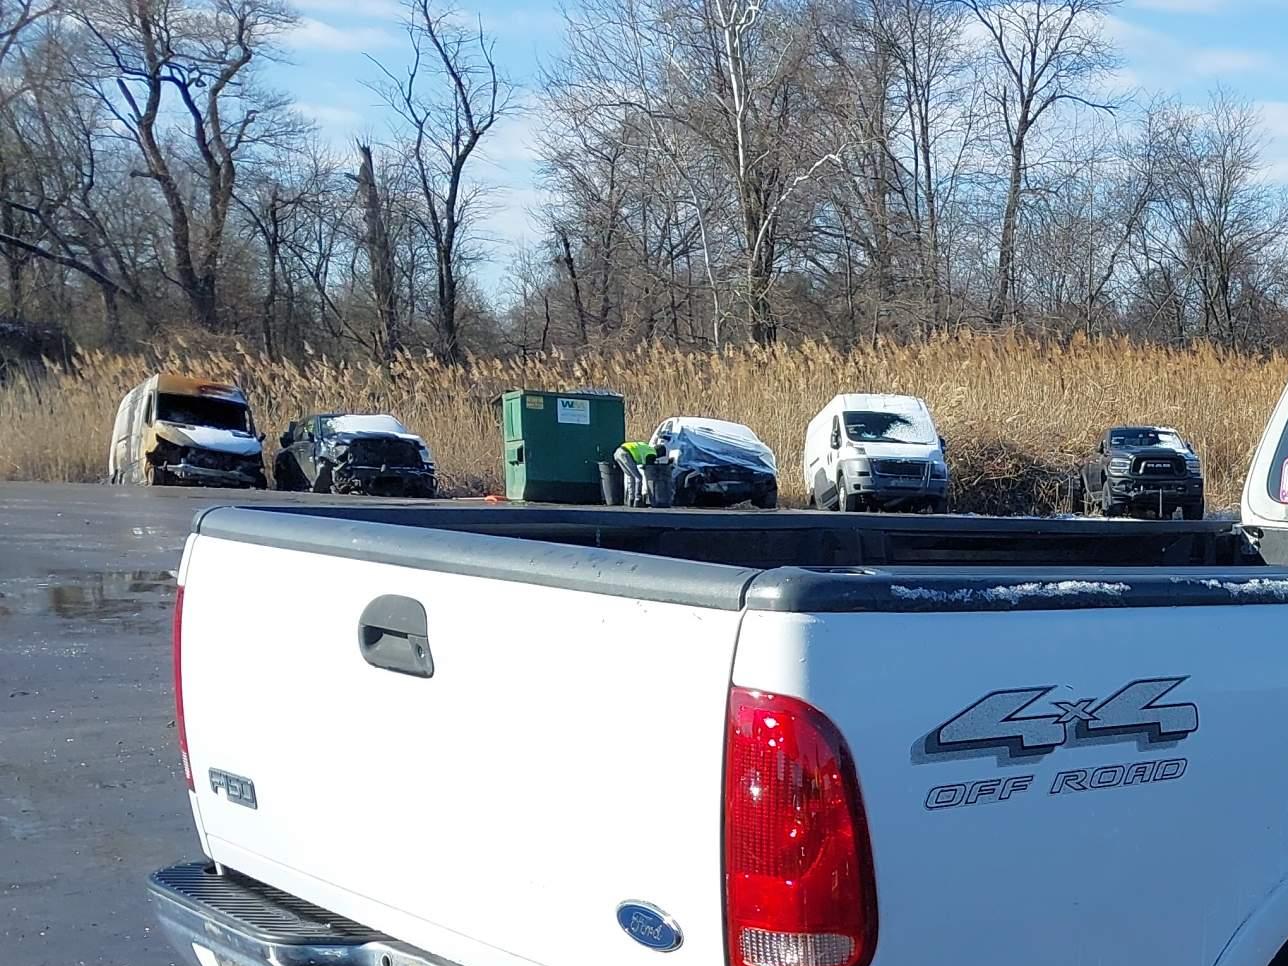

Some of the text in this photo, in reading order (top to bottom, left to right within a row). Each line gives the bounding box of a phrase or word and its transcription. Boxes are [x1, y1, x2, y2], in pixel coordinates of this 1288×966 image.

[924, 757, 1189, 811] OFF ROAD
[630, 911, 663, 941] Ford
